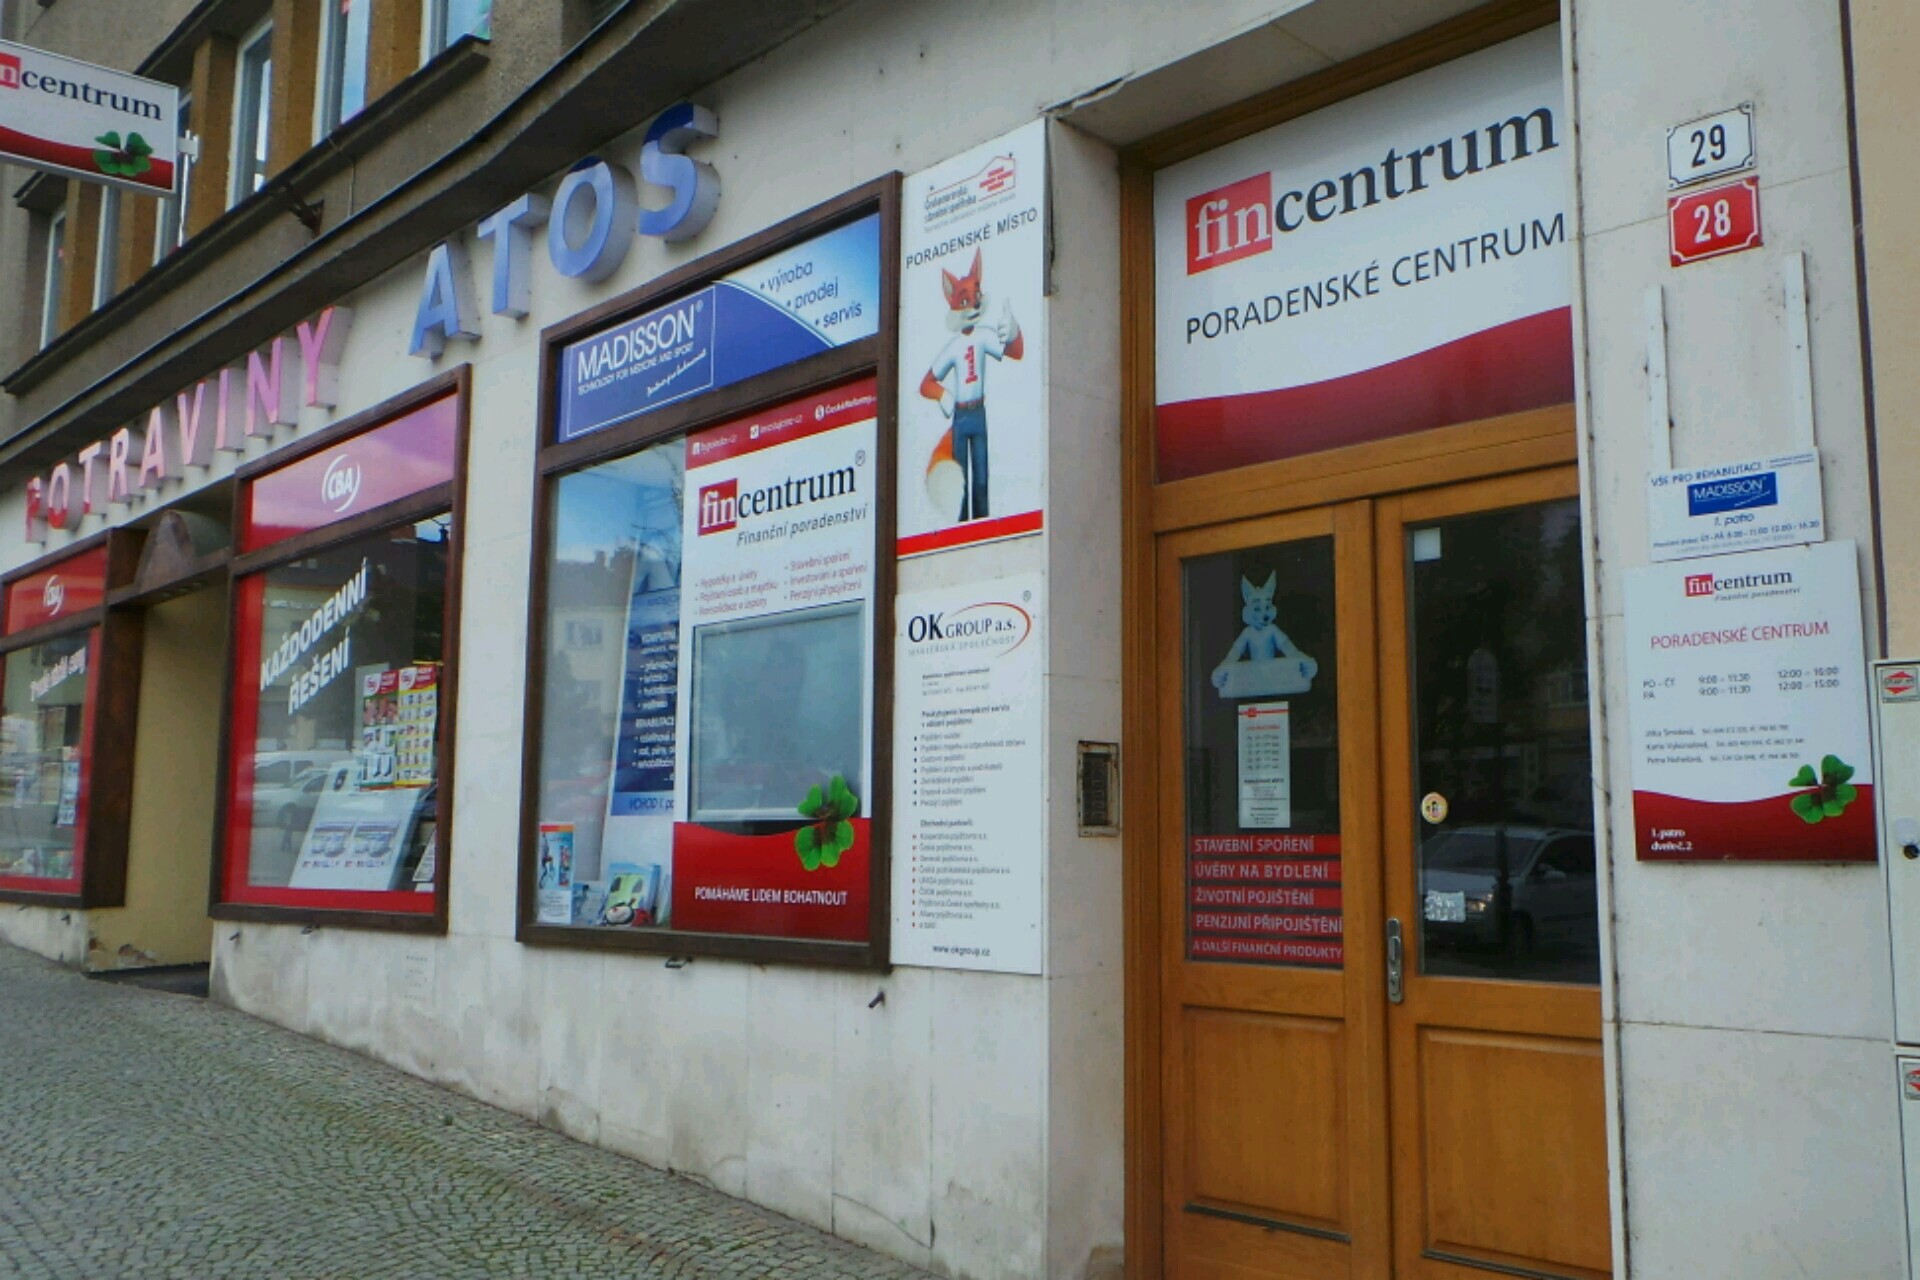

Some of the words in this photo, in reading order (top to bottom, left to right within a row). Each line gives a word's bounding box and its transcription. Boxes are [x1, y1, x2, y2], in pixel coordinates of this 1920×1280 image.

[1690, 124, 1726, 168] 29
[1194, 106, 1560, 262] fincentrum
[1694, 199, 1731, 244] 28
[906, 224, 990, 269] PORADENSKÉ
[997, 207, 1038, 236] MÍSTO
[767, 260, 814, 293] výroba
[1186, 260, 1381, 344] PORADENSKÉ
[1392, 212, 1566, 288] CENTRUM
[794, 277, 839, 311] prodej
[25, 305, 338, 543] POTRAVINY
[408, 102, 696, 356] ATOS
[823, 300, 863, 329] servis
[577, 303, 695, 384] MADISSON
[328, 470, 353, 500] CBA
[1672, 472, 1693, 484] PRO
[1694, 478, 1764, 499] MADISSON
[700, 465, 856, 529] fincentrum
[736, 520, 788, 547] Finanční
[789, 502, 869, 539] poradenství
[1688, 572, 1793, 594] fincentrum
[261, 557, 368, 692] KAŽDODENNÍ
[1650, 627, 1748, 649] PORADENSKÉ
[1752, 621, 1829, 641] CENTRUM
[288, 626, 351, 715] ŘEŠENÍ
[1778, 669, 1802, 679] 12:00
[1195, 836, 1253, 853] STAVEBNÍ
[1257, 835, 1315, 852] SPOŘENÍ
[1195, 861, 1235, 878] ÚVĚRY
[1240, 864, 1259, 877] NA
[1264, 861, 1329, 878] BYDLENÍ
[695, 885, 750, 901] POMÁHÁME
[752, 888, 781, 903] LIDEM
[784, 890, 848, 905] BOHATNOUT
[1195, 886, 1246, 904] ŽIVOTNÍ
[1248, 887, 1314, 906] POJIŠTĚNÍ
[1196, 913, 1251, 930] PENZIJNÍ
[1253, 914, 1343, 934] PŘIPOJIŠTĚNÍ
[1202, 939, 1231, 953] DALŠÍ
[1232, 940, 1281, 955] FINANČNÍ
[1283, 943, 1342, 959] PRODUKTY
